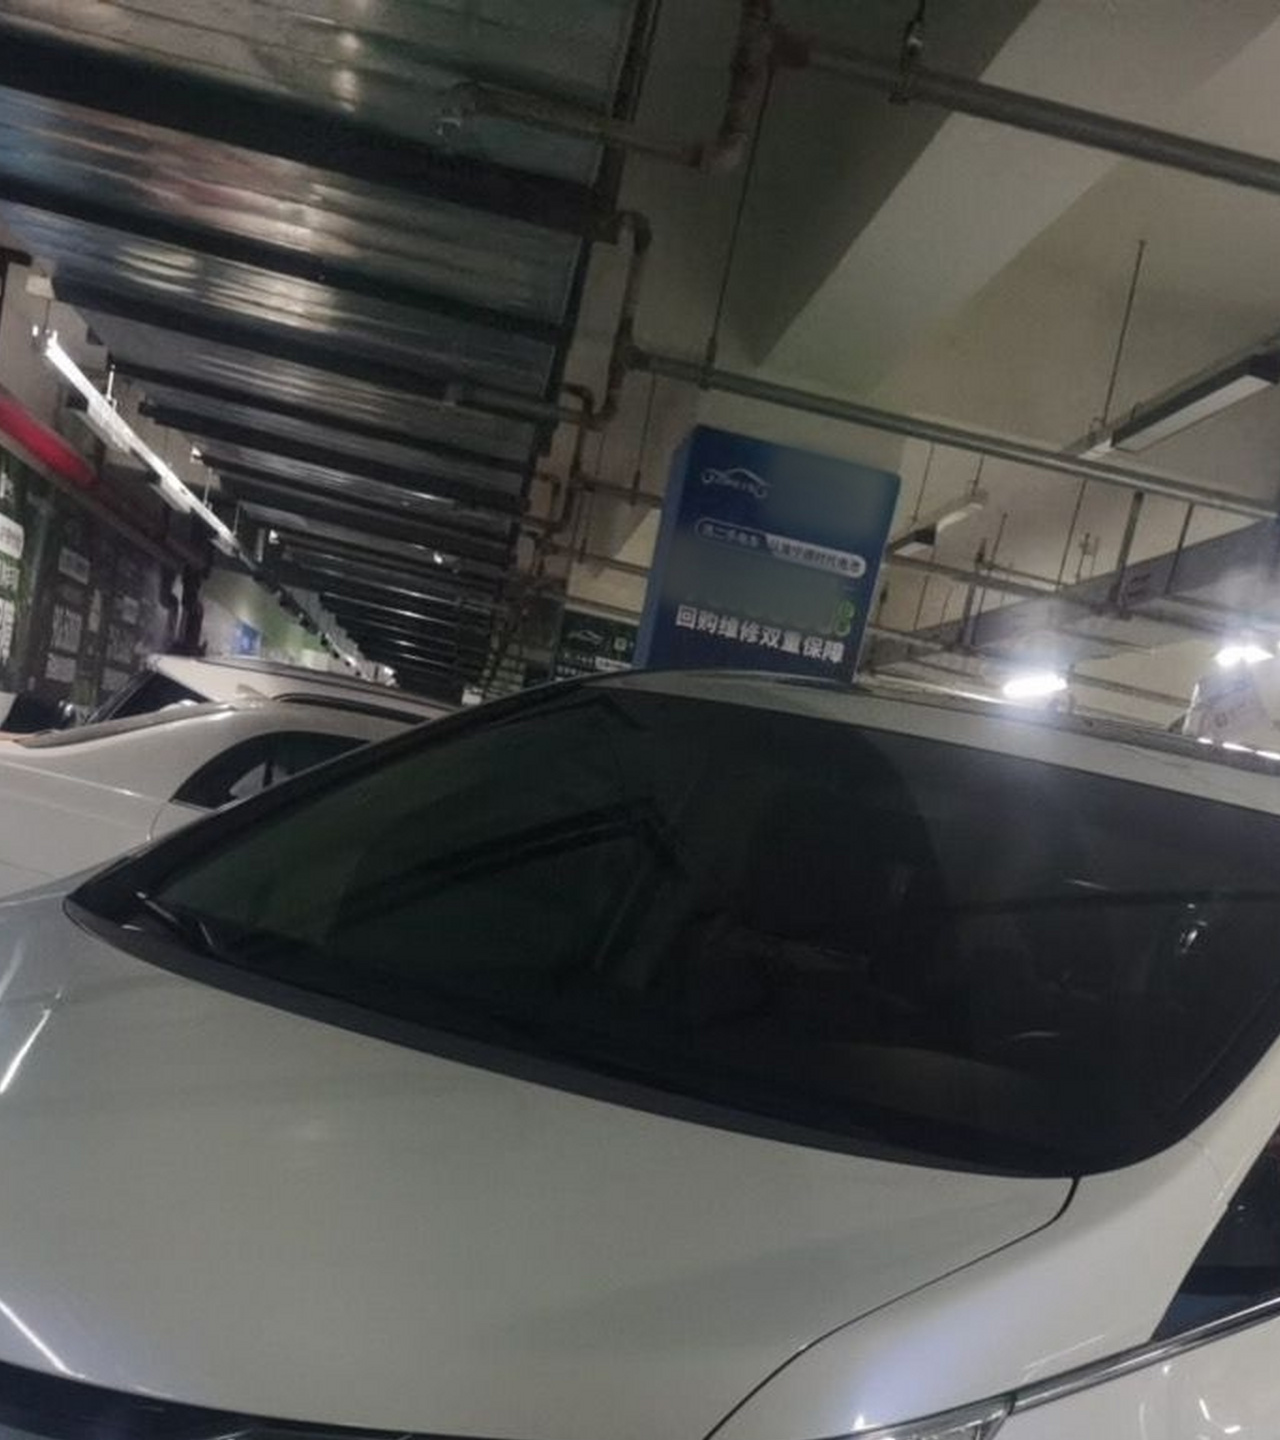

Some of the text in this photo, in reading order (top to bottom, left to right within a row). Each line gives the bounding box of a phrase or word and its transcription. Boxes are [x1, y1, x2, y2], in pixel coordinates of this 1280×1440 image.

[675, 603, 846, 664] 回购维修双重保障
